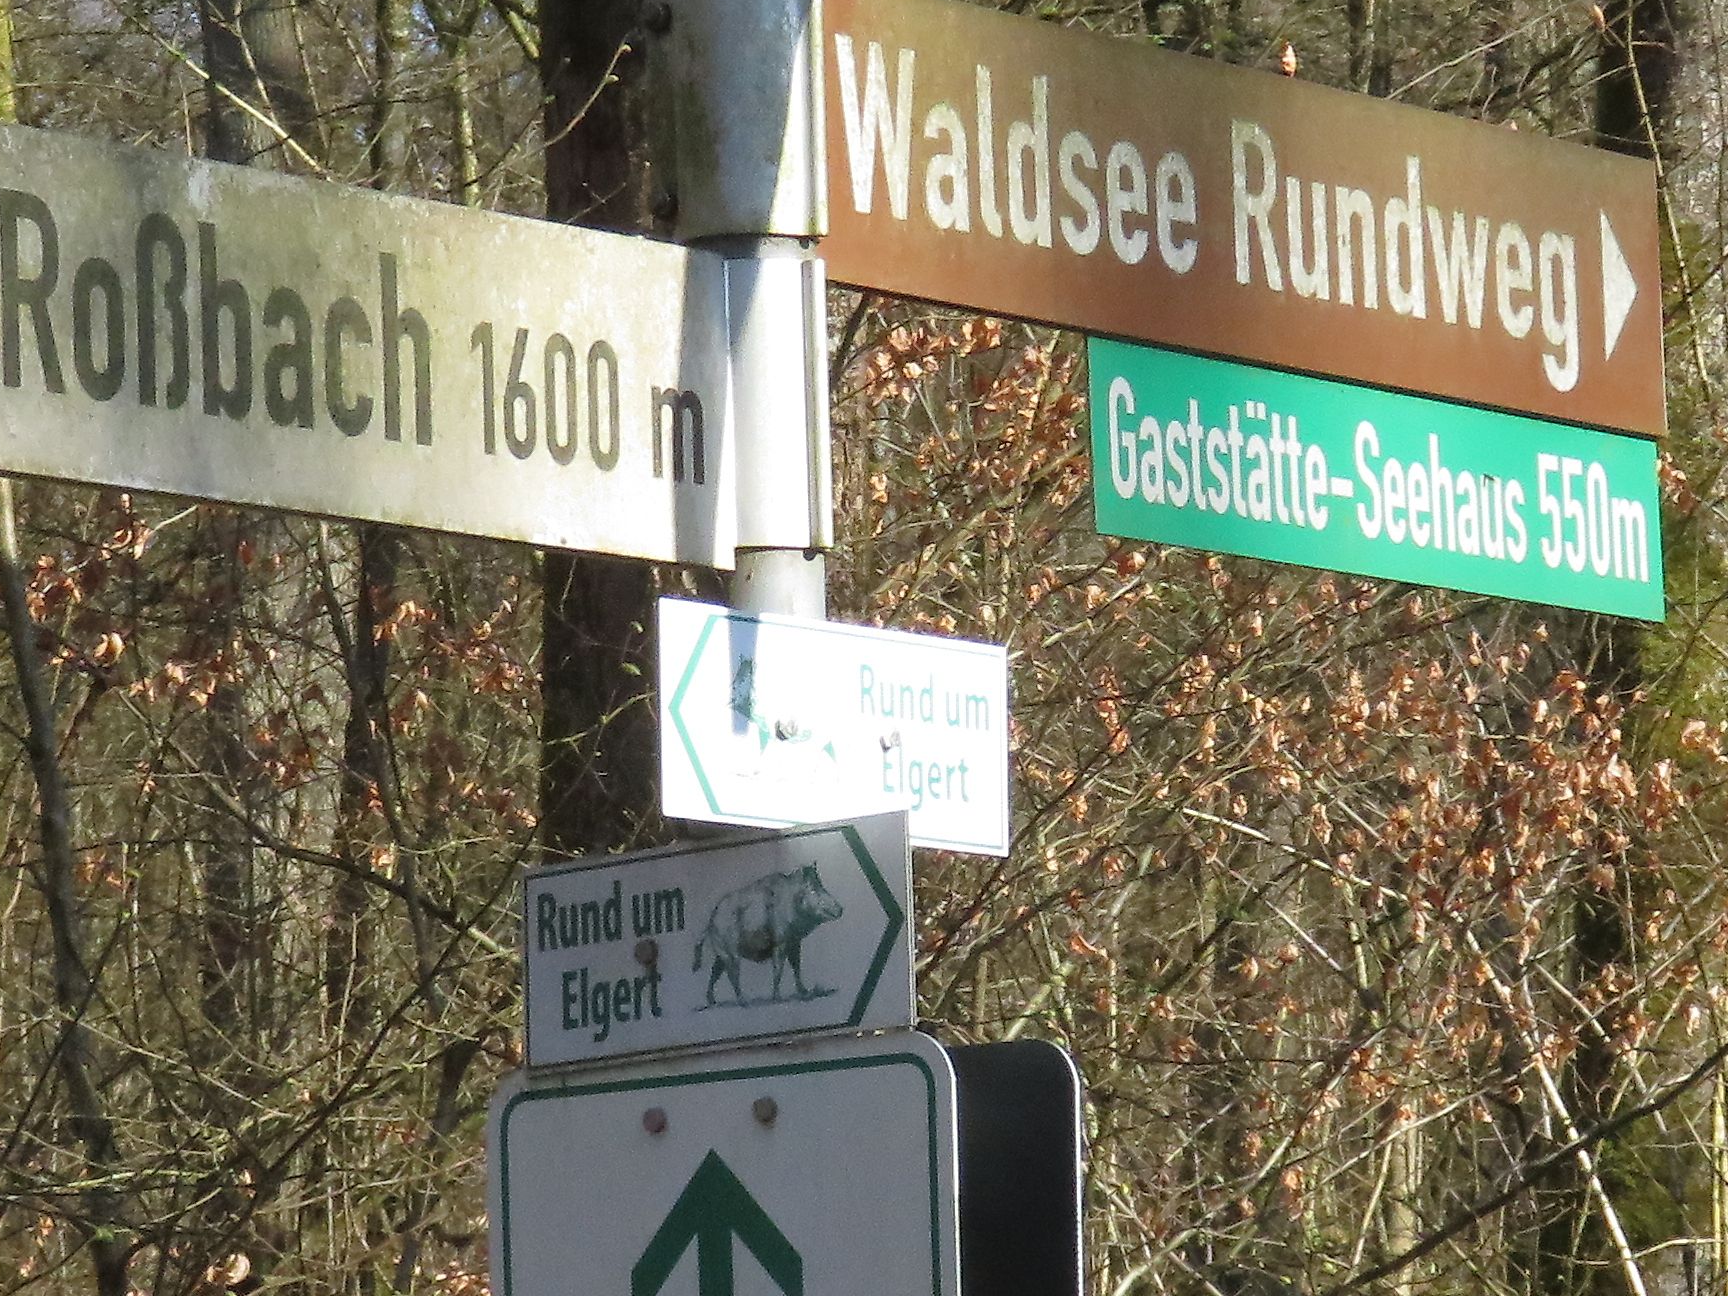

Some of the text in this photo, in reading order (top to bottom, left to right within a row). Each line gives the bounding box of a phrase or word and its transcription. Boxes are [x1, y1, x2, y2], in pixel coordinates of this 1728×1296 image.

[834, 32, 1580, 394] Waldsee Rundweg
[470, 320, 621, 473] 1600
[651, 383, 705, 486] m
[1107, 375, 1651, 584] Gaststätte-Seehaus 550m
[859, 663, 991, 731] Rund um
[882, 742, 970, 812] Elgert
[536, 880, 686, 953] Rund um
[560, 962, 663, 1043] Elgert
